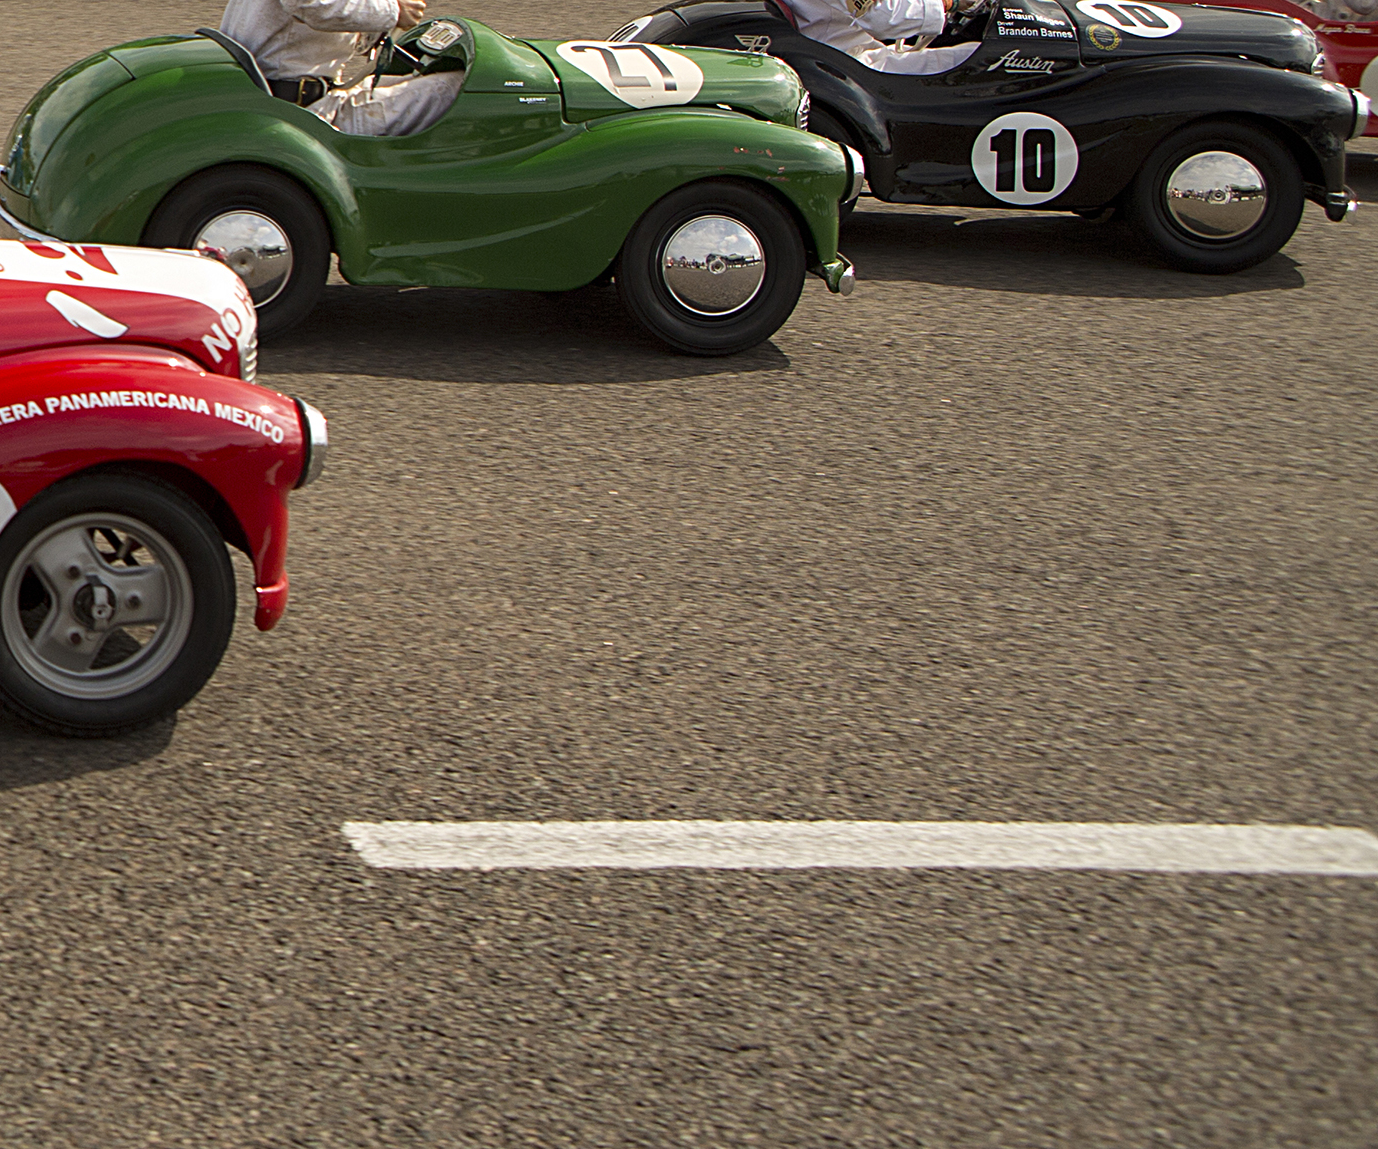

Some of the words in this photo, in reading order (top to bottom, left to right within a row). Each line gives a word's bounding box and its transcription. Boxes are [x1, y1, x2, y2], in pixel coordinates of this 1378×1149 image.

[1004, 11, 1035, 22] Shaun
[1089, 3, 1170, 29] 10
[998, 26, 1039, 37] Brandon
[1040, 27, 1074, 39] Barnes
[570, 43, 678, 92] 27
[987, 49, 1056, 74] Austin
[990, 128, 1056, 193] 10
[45, 390, 211, 416] PANAMERICANA
[213, 401, 285, 445] MEXICO
